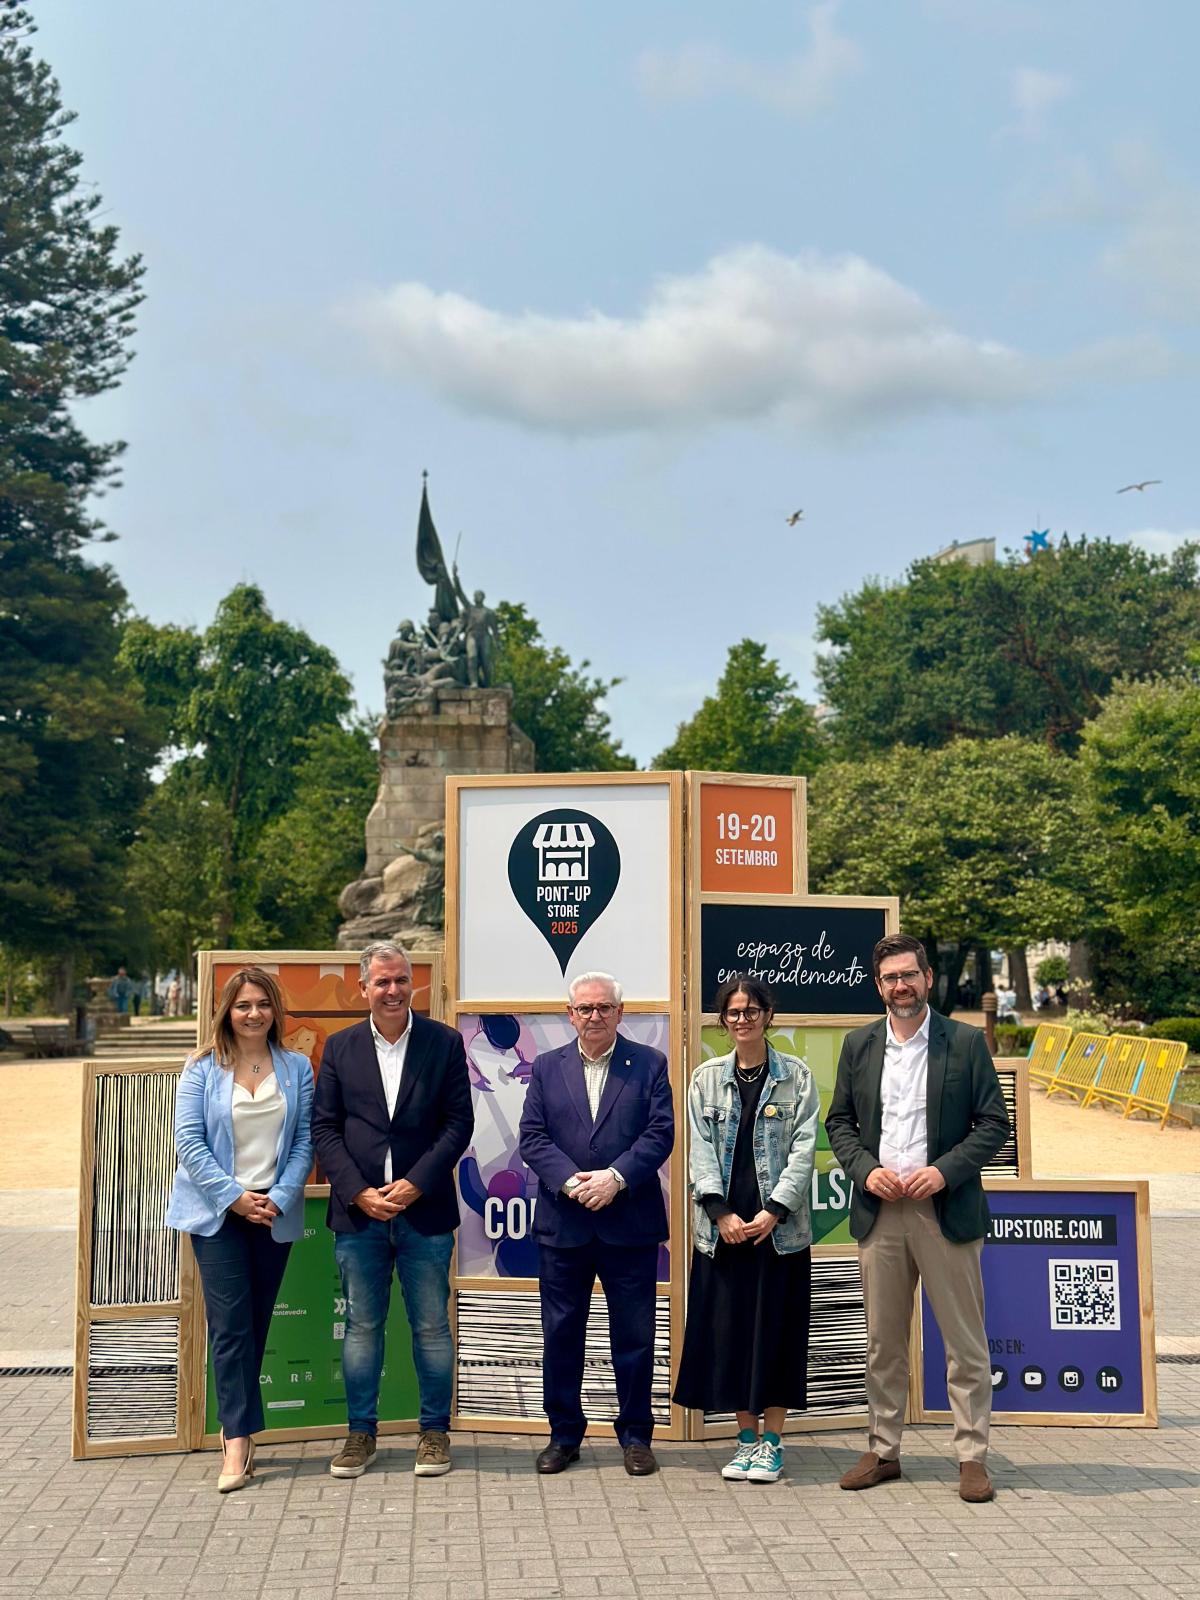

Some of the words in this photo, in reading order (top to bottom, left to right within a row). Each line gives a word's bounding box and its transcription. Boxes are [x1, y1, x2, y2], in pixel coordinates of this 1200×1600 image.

[716, 812, 776, 842] 19-20
[715, 848, 778, 867] SETEMBRO
[536, 885, 592, 902] PONT-UP
[547, 904, 580, 918] STORE
[551, 921, 578, 935] 2025
[737, 941, 808, 969] espazo
[811, 930, 835, 960] de
[811, 1167, 855, 1211] LS
[484, 1196, 538, 1240] CO
[987, 1219, 1103, 1240] UPSTORE.COM
